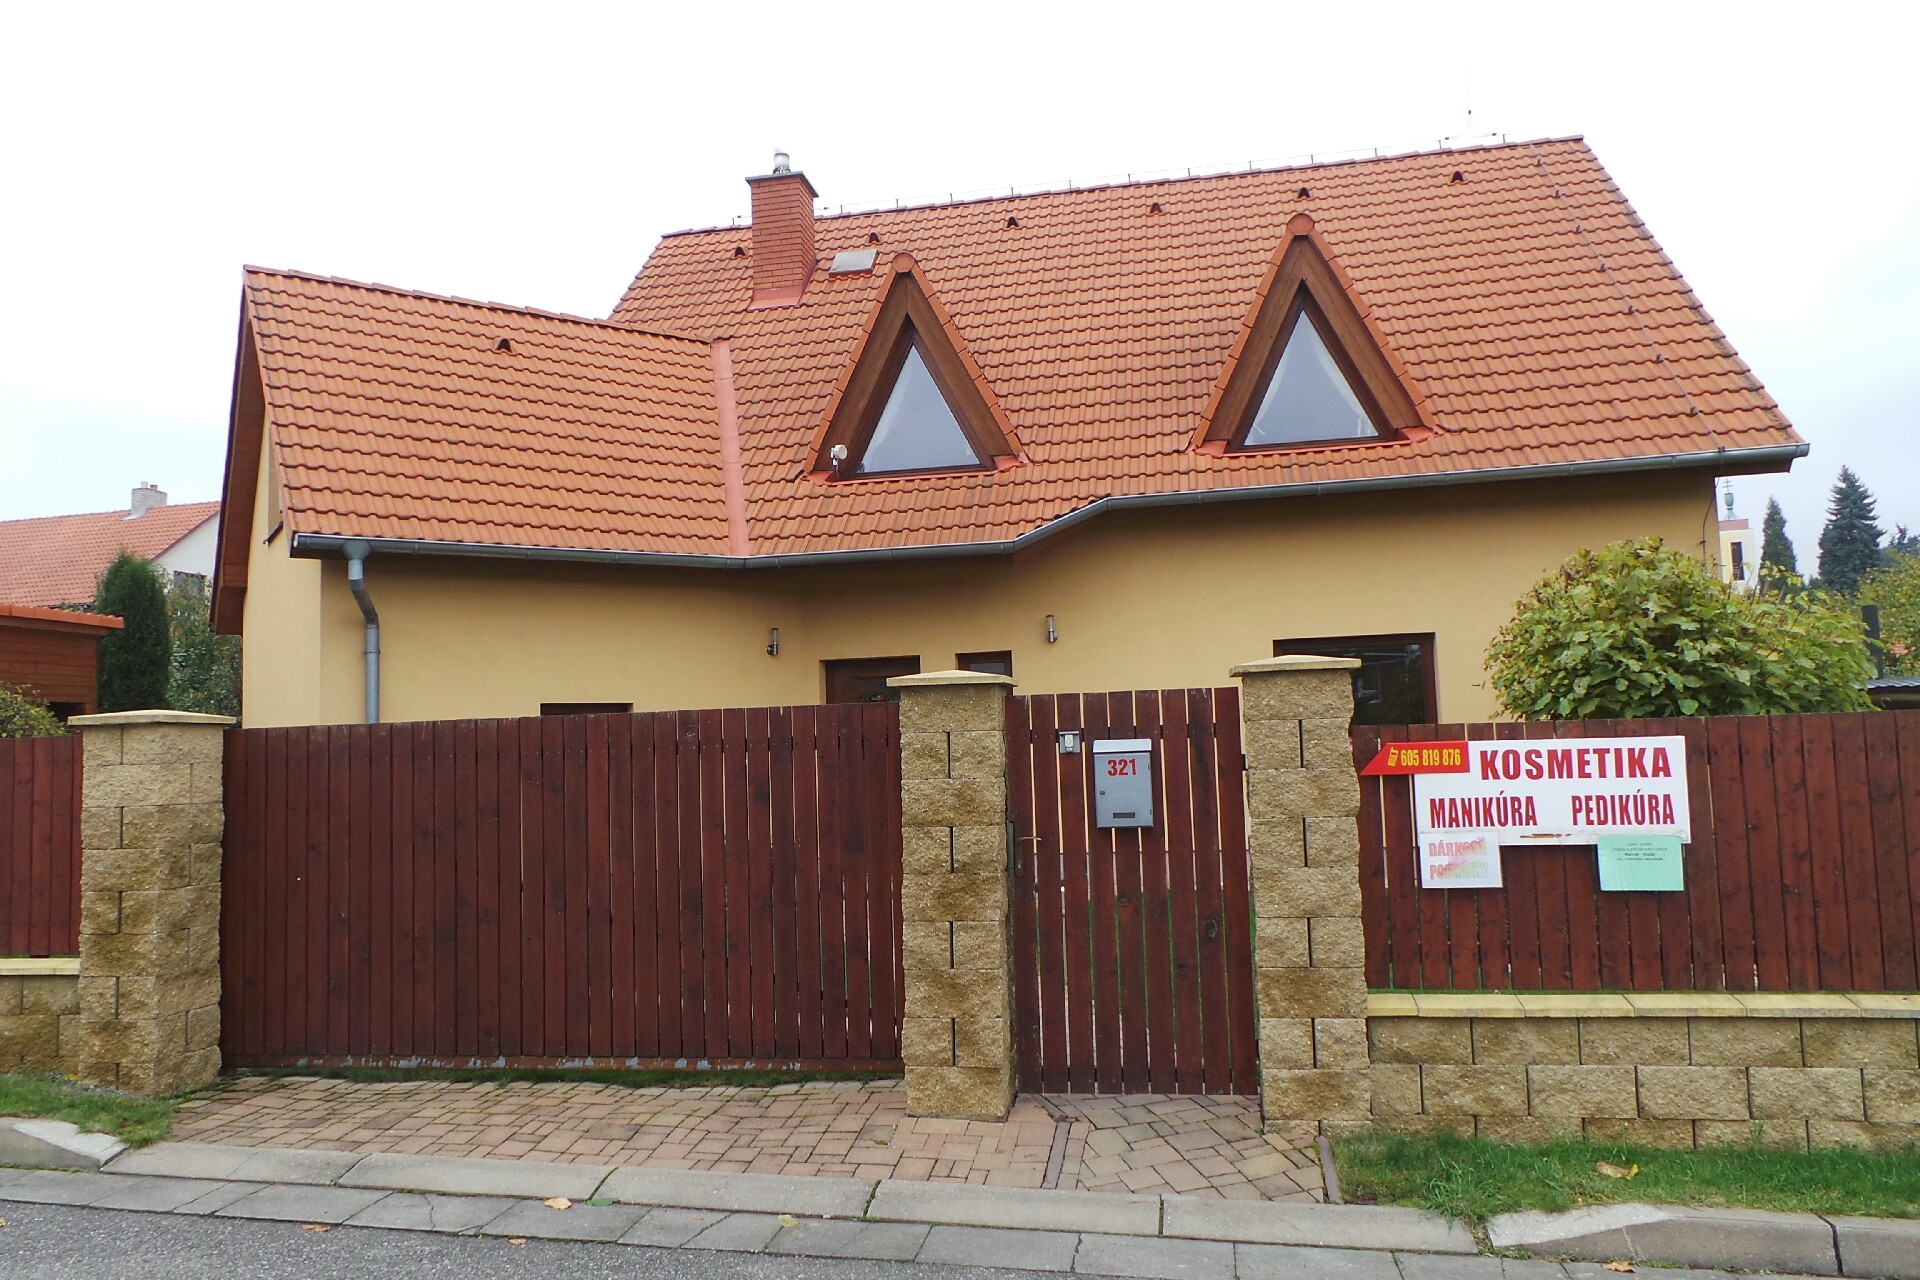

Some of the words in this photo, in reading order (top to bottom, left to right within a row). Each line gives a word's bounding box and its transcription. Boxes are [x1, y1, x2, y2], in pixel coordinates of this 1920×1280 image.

[1107, 759, 1137, 776] 321
[1401, 749, 1419, 766] 605
[1423, 749, 1439, 766] 819
[1443, 748, 1461, 766] 876
[1480, 747, 1672, 780] KOSMETIKA
[1430, 791, 1537, 828] MANIKÚRA
[1572, 789, 1675, 826] PEDIKÚRA
